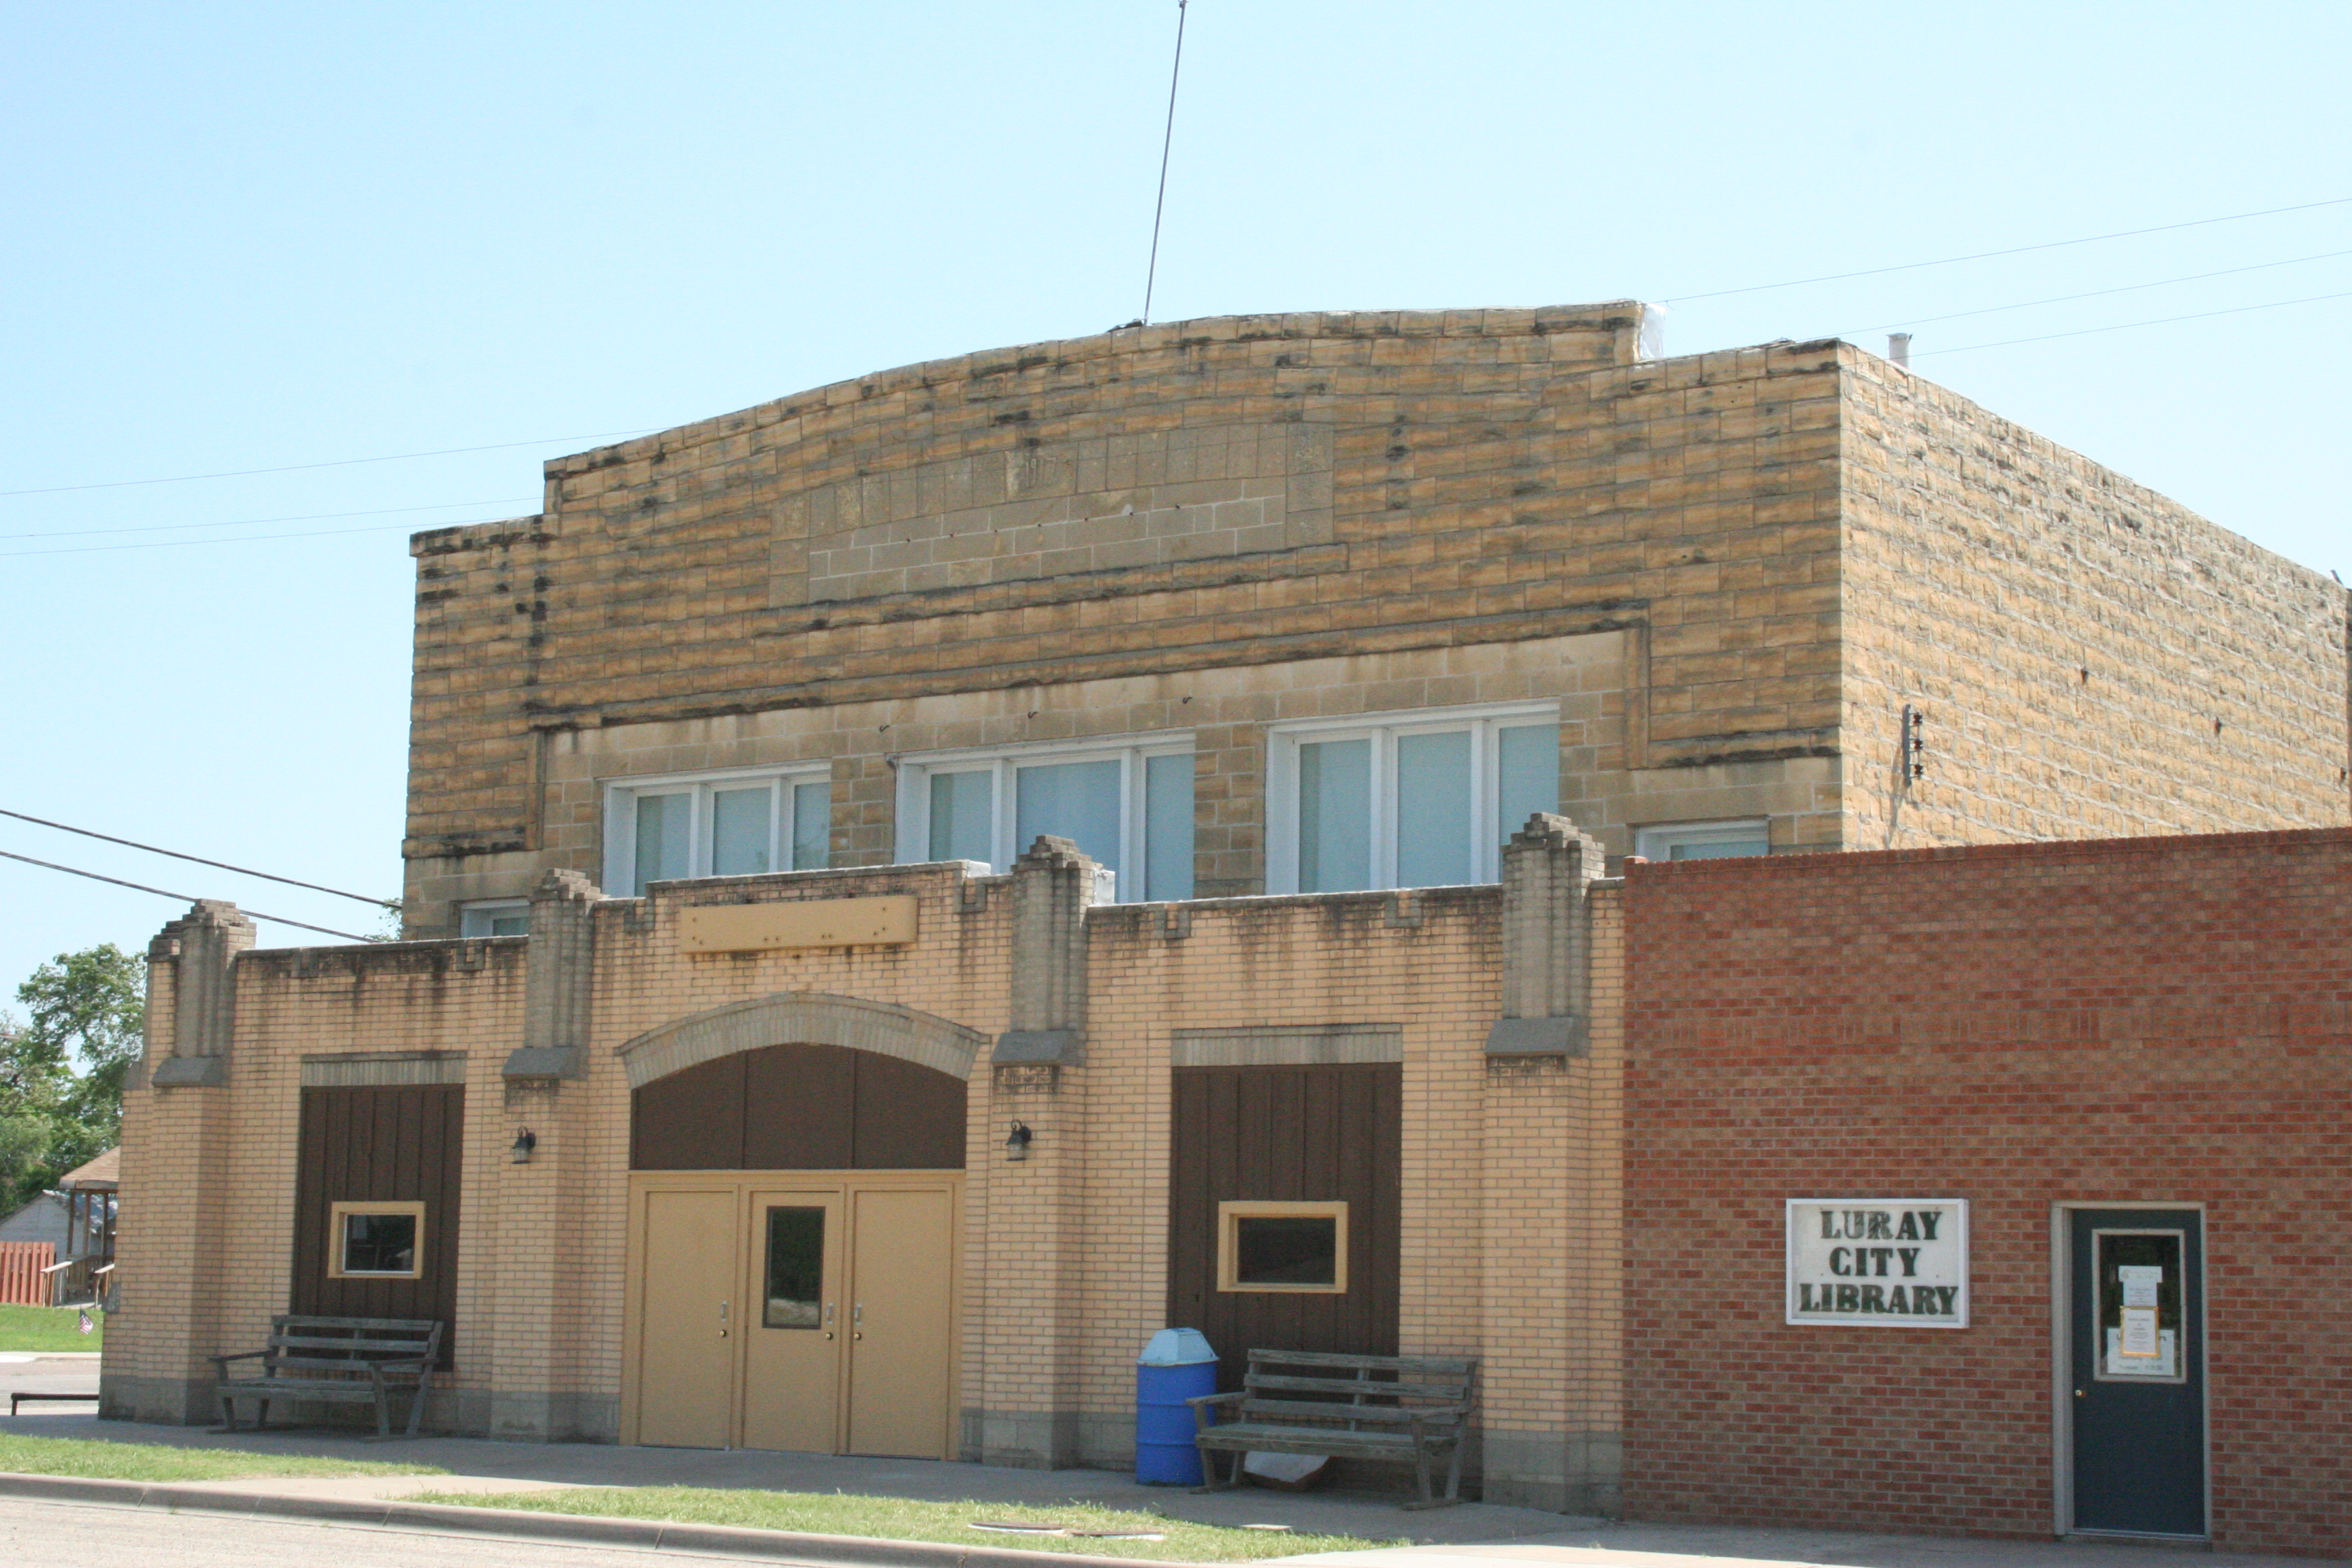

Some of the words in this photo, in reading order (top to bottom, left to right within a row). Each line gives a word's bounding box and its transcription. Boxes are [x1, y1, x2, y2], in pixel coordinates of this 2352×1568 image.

[1820, 1211, 1942, 1240] LURAY
[1829, 1247, 1921, 1276] CITY
[1799, 1284, 1959, 1315] LIBRARY
